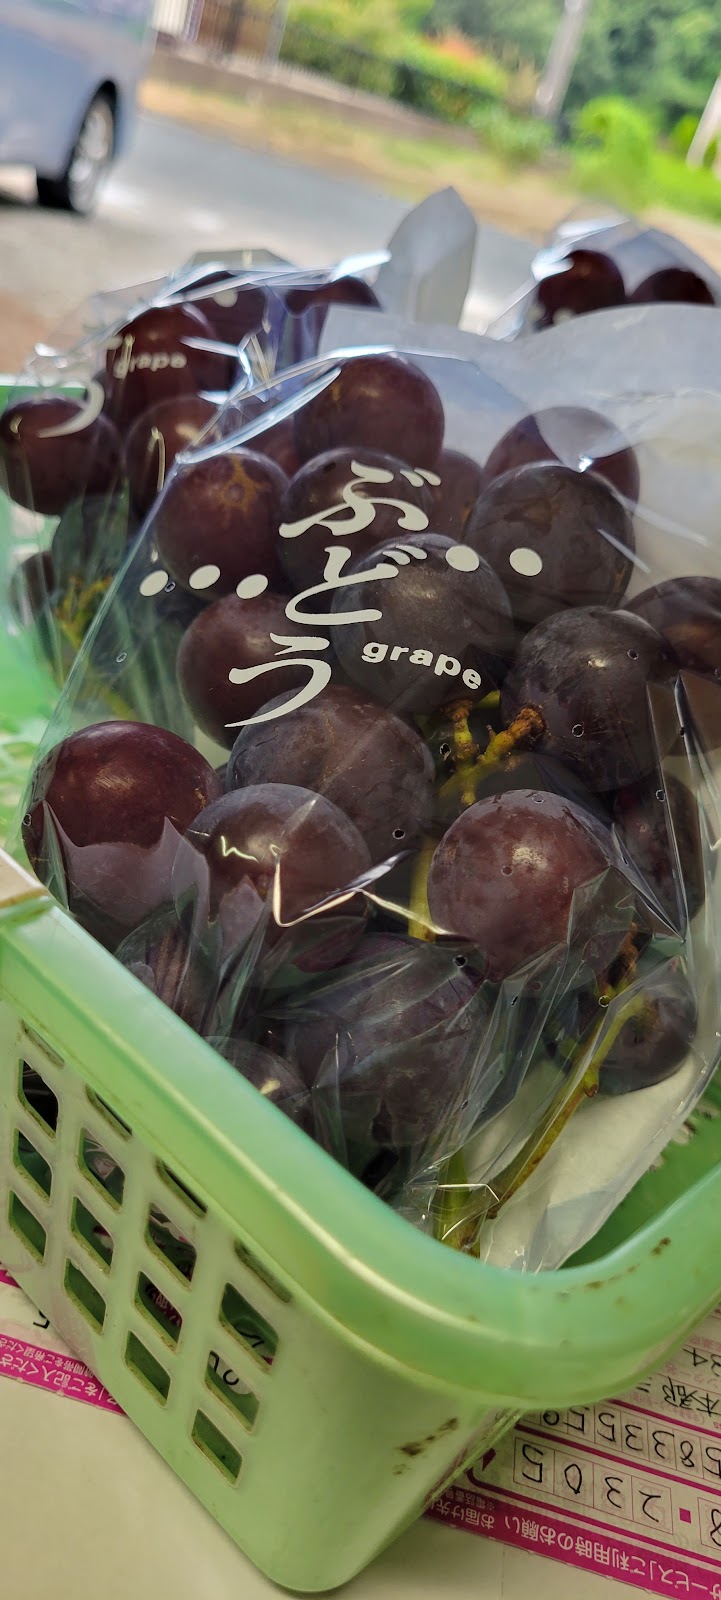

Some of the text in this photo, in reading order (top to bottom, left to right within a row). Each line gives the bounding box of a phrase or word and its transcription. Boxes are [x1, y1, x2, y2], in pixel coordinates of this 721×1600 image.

[225, 460, 441, 727] ぶどう
[361, 641, 482, 690] grape
